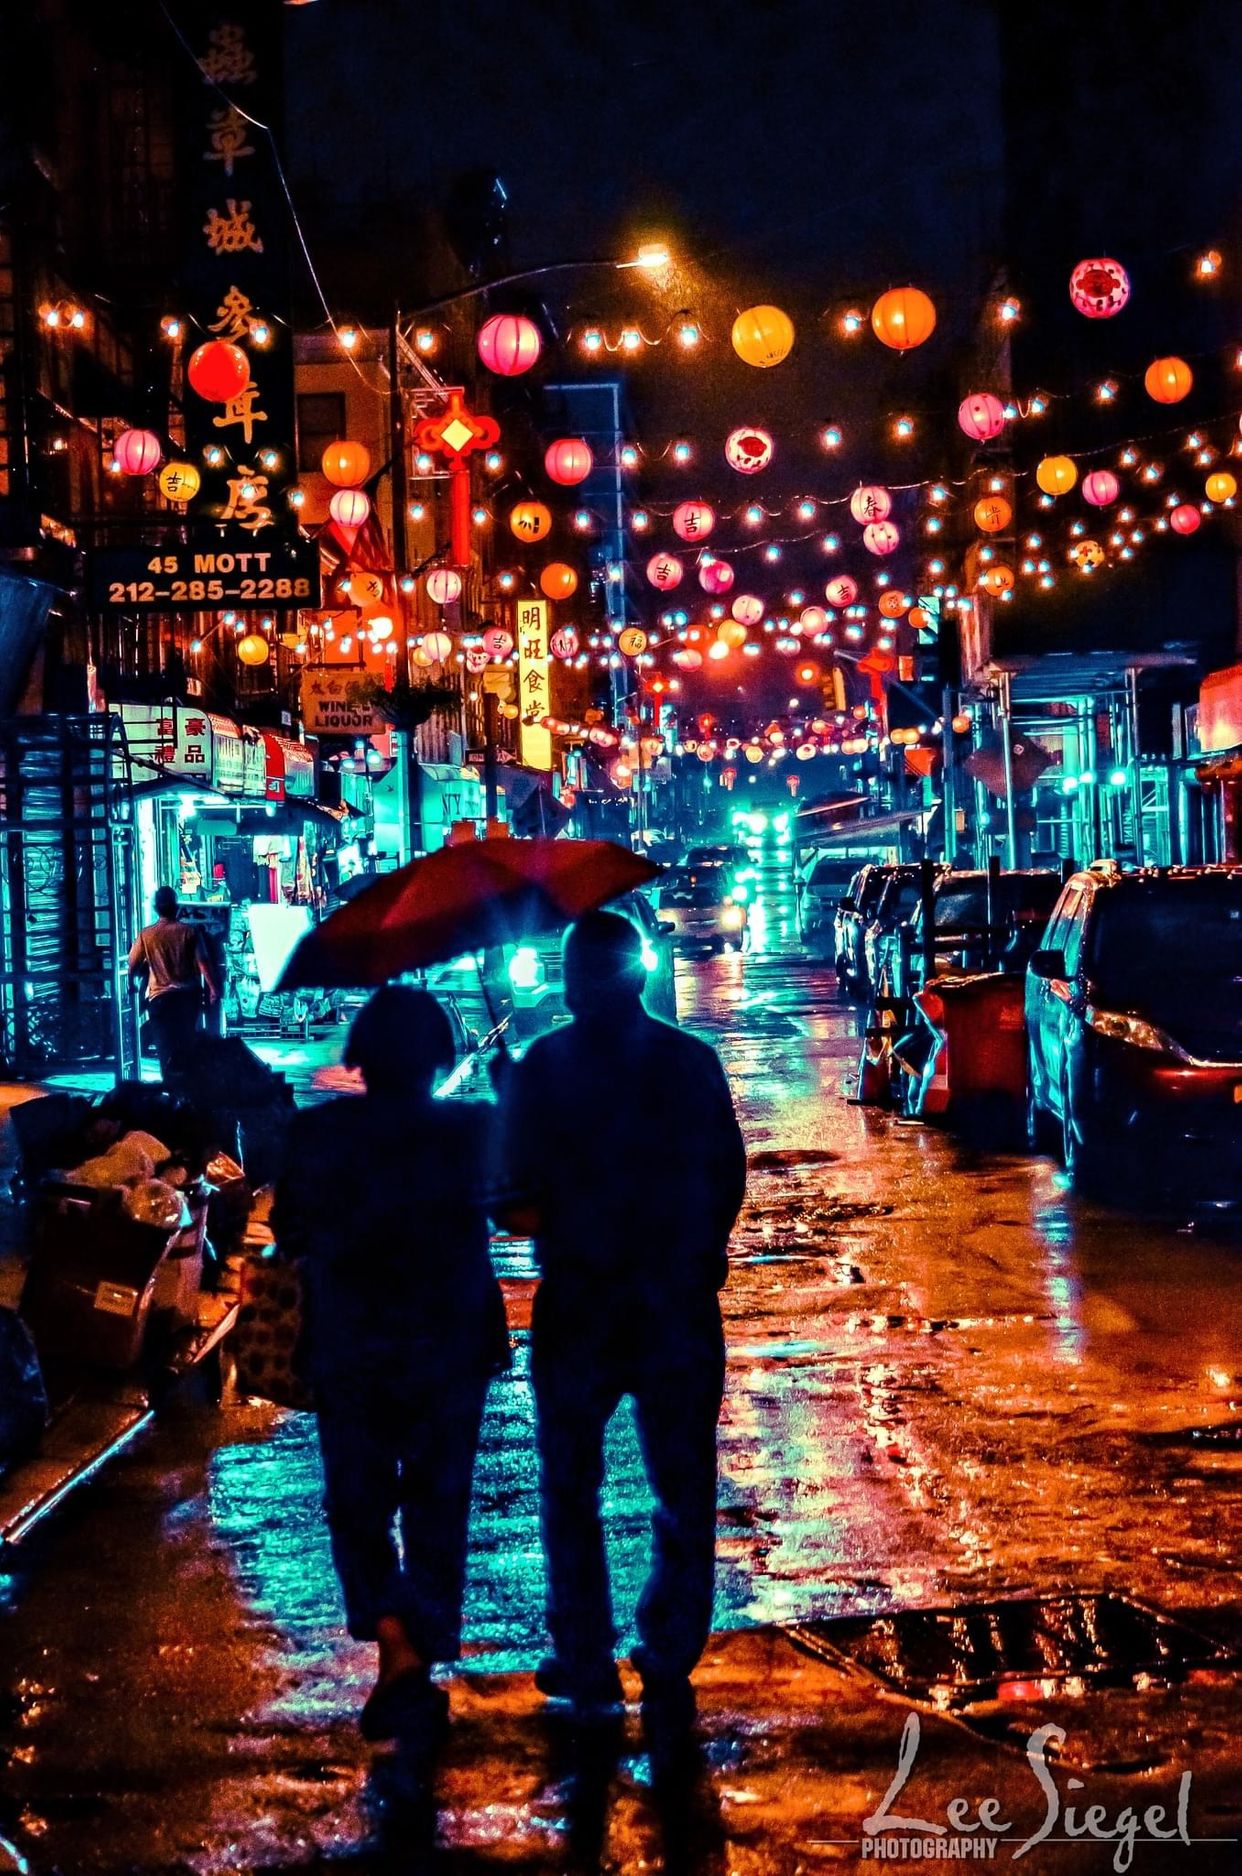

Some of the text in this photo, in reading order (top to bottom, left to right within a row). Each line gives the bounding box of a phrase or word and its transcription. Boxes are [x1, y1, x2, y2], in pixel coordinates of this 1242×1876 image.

[684, 514, 701, 533] 吉
[147, 552, 271, 574] 45 MOTT
[109, 578, 311, 603] 212-285-2288
[315, 715, 373, 727] LIQUOR
